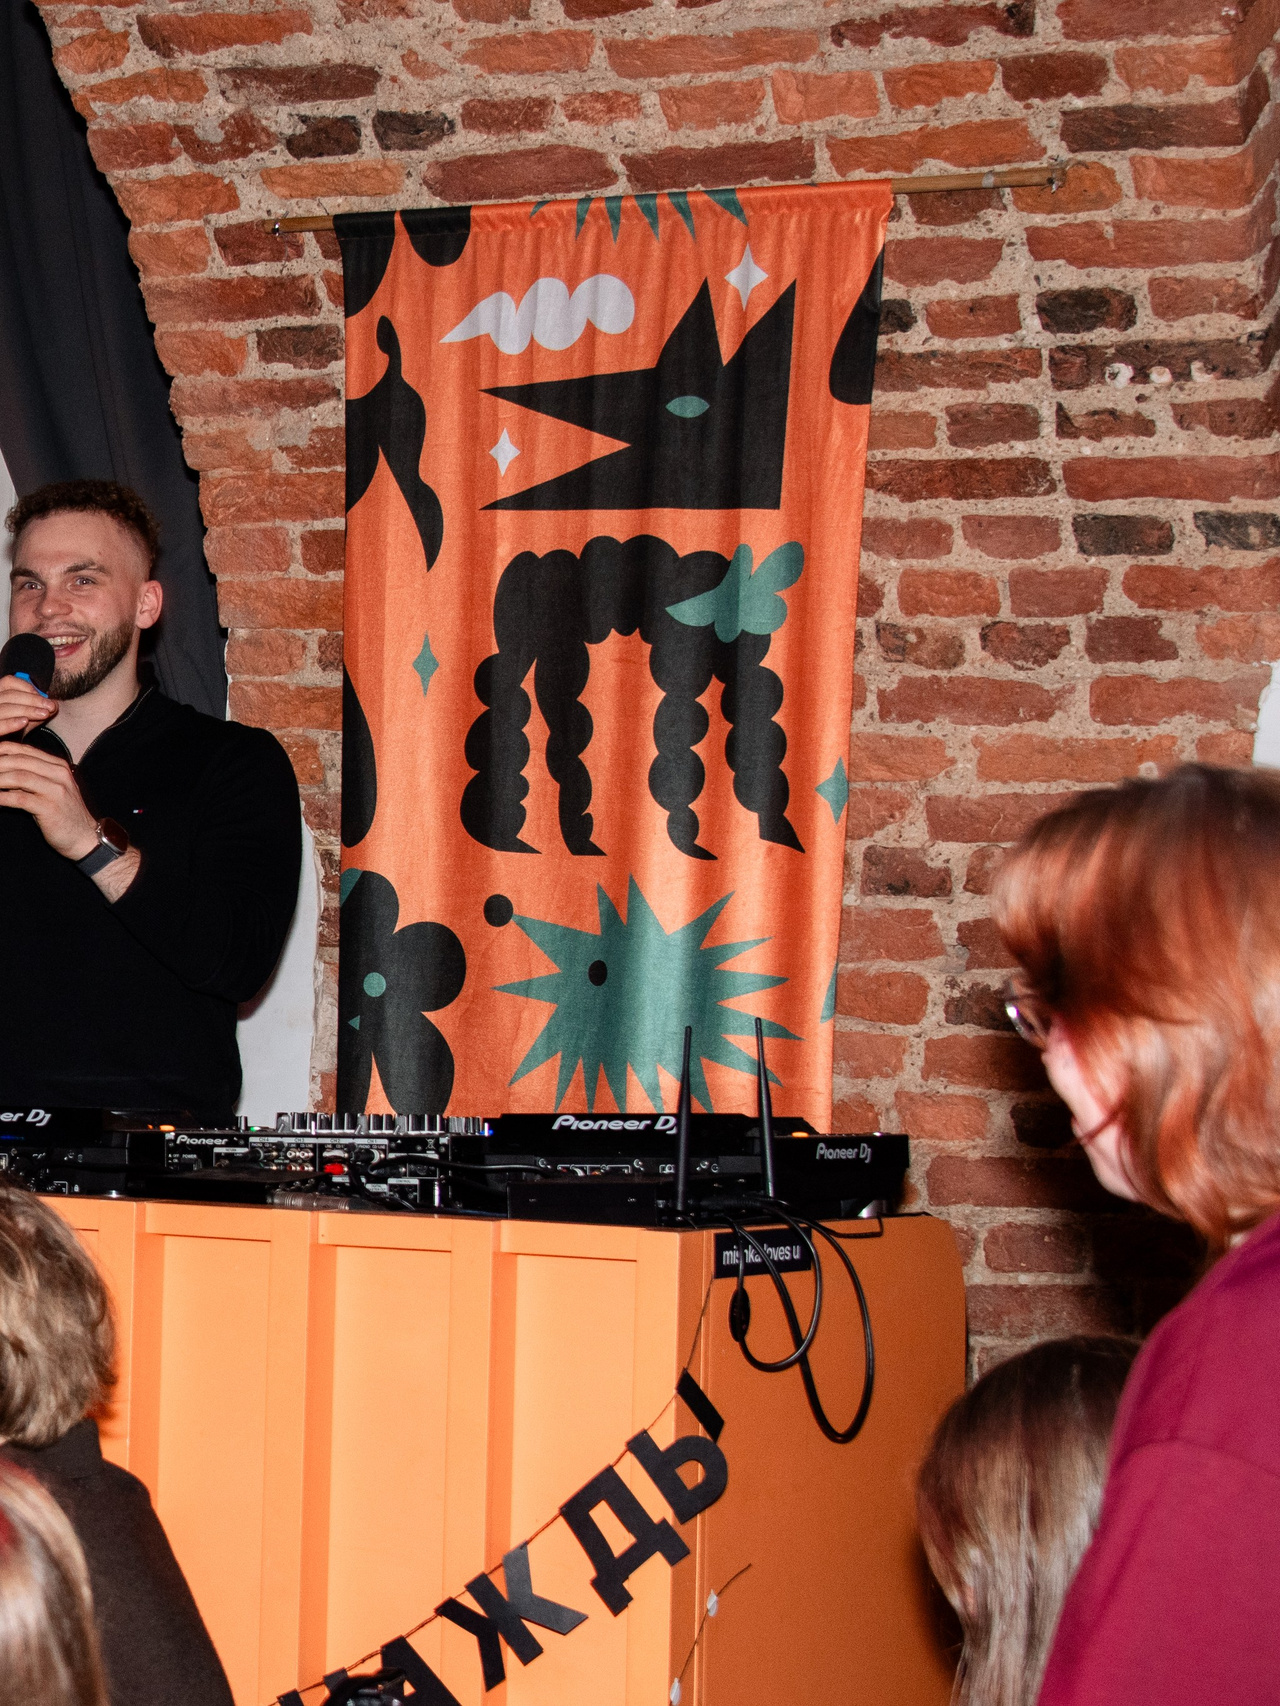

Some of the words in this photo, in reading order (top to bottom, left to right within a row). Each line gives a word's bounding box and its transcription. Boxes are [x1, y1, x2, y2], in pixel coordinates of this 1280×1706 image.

[551, 1114, 652, 1130] Pioneer
[176, 1134, 228, 1145] Pioneer
[815, 1142, 858, 1160] Pioneer
